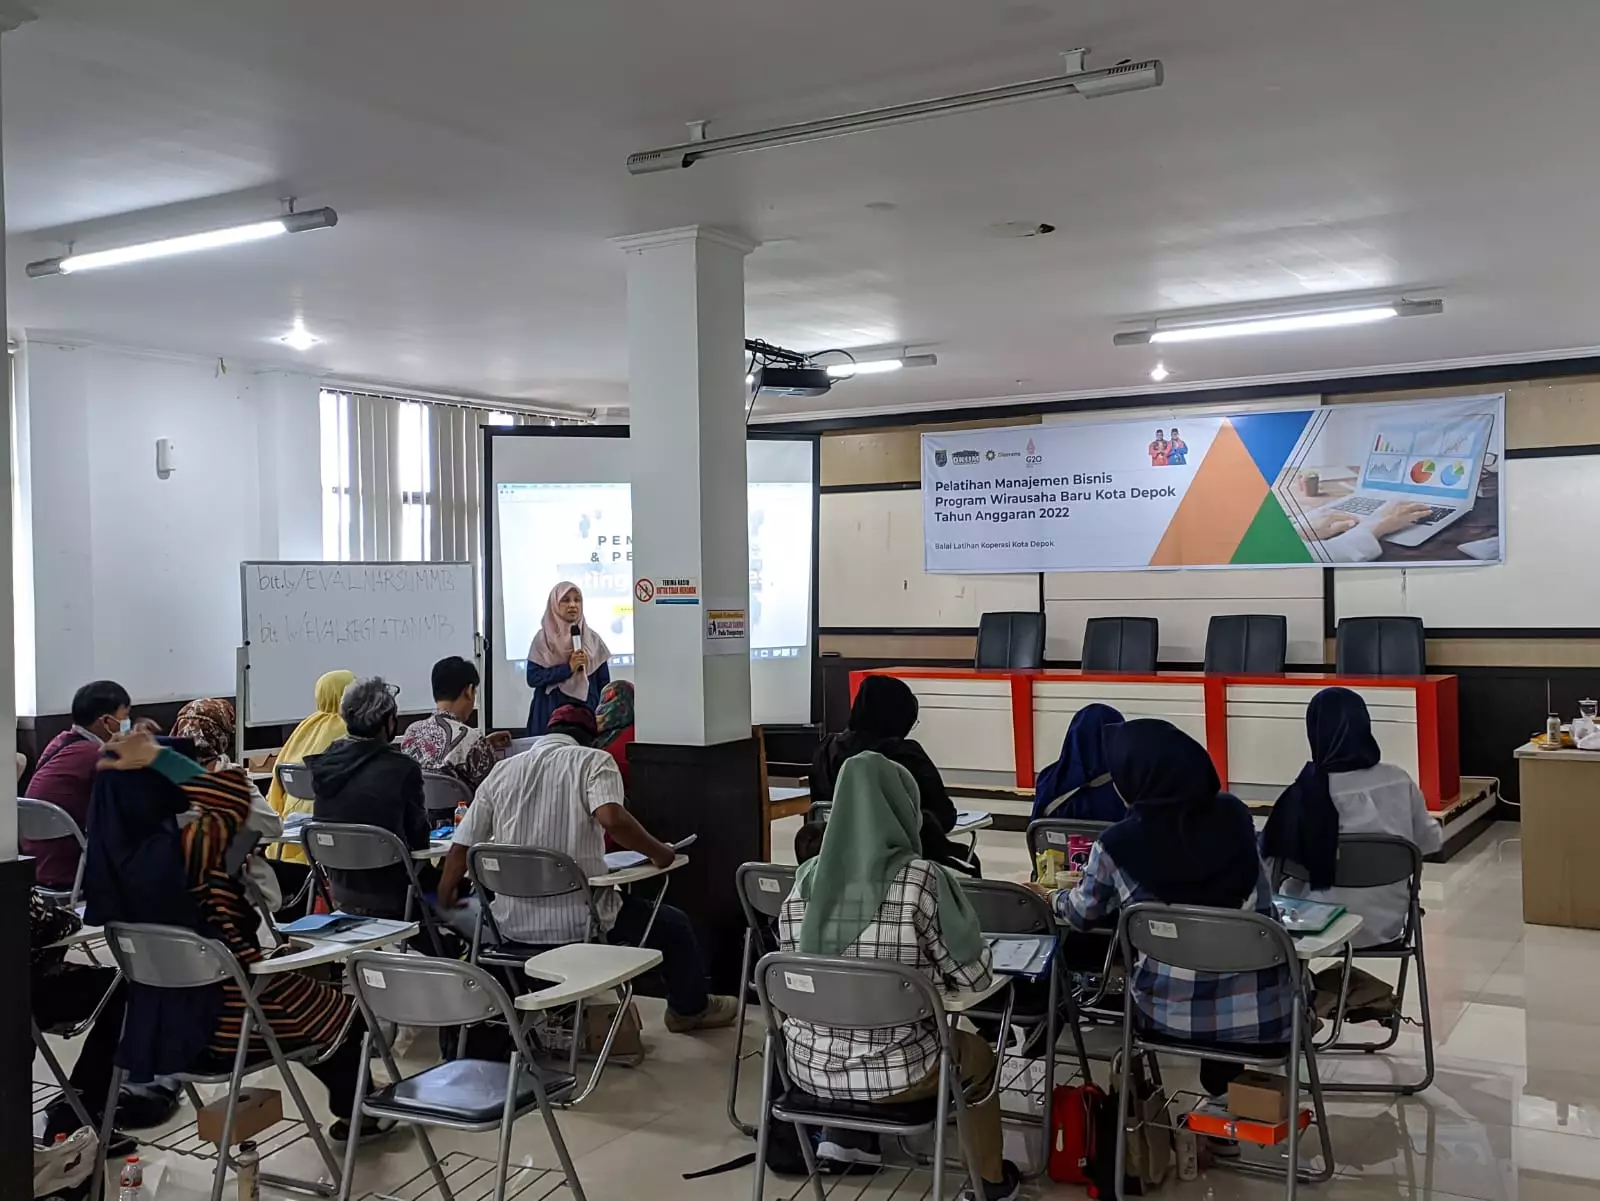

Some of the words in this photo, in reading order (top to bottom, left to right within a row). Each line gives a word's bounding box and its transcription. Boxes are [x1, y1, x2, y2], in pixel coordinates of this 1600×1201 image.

[935, 480, 992, 491] Pelatihan
[995, 475, 1069, 489] Manajemen
[1073, 472, 1113, 485] Bisnis
[935, 497, 987, 508] Program
[990, 492, 1057, 504] Wirausaha
[1060, 491, 1092, 502] Baru
[1095, 489, 1127, 500] Kota
[1130, 486, 1177, 500] Depok
[934, 511, 972, 522] Tahun
[975, 510, 1036, 522] Anggaran
[1039, 507, 1070, 519] 2022
[935, 542, 952, 550] Balai
[953, 542, 980, 550] Latihan
[981, 541, 1011, 550] Koperasi
[1030, 540, 1055, 549] Depok
[590, 552, 600, 562] &
